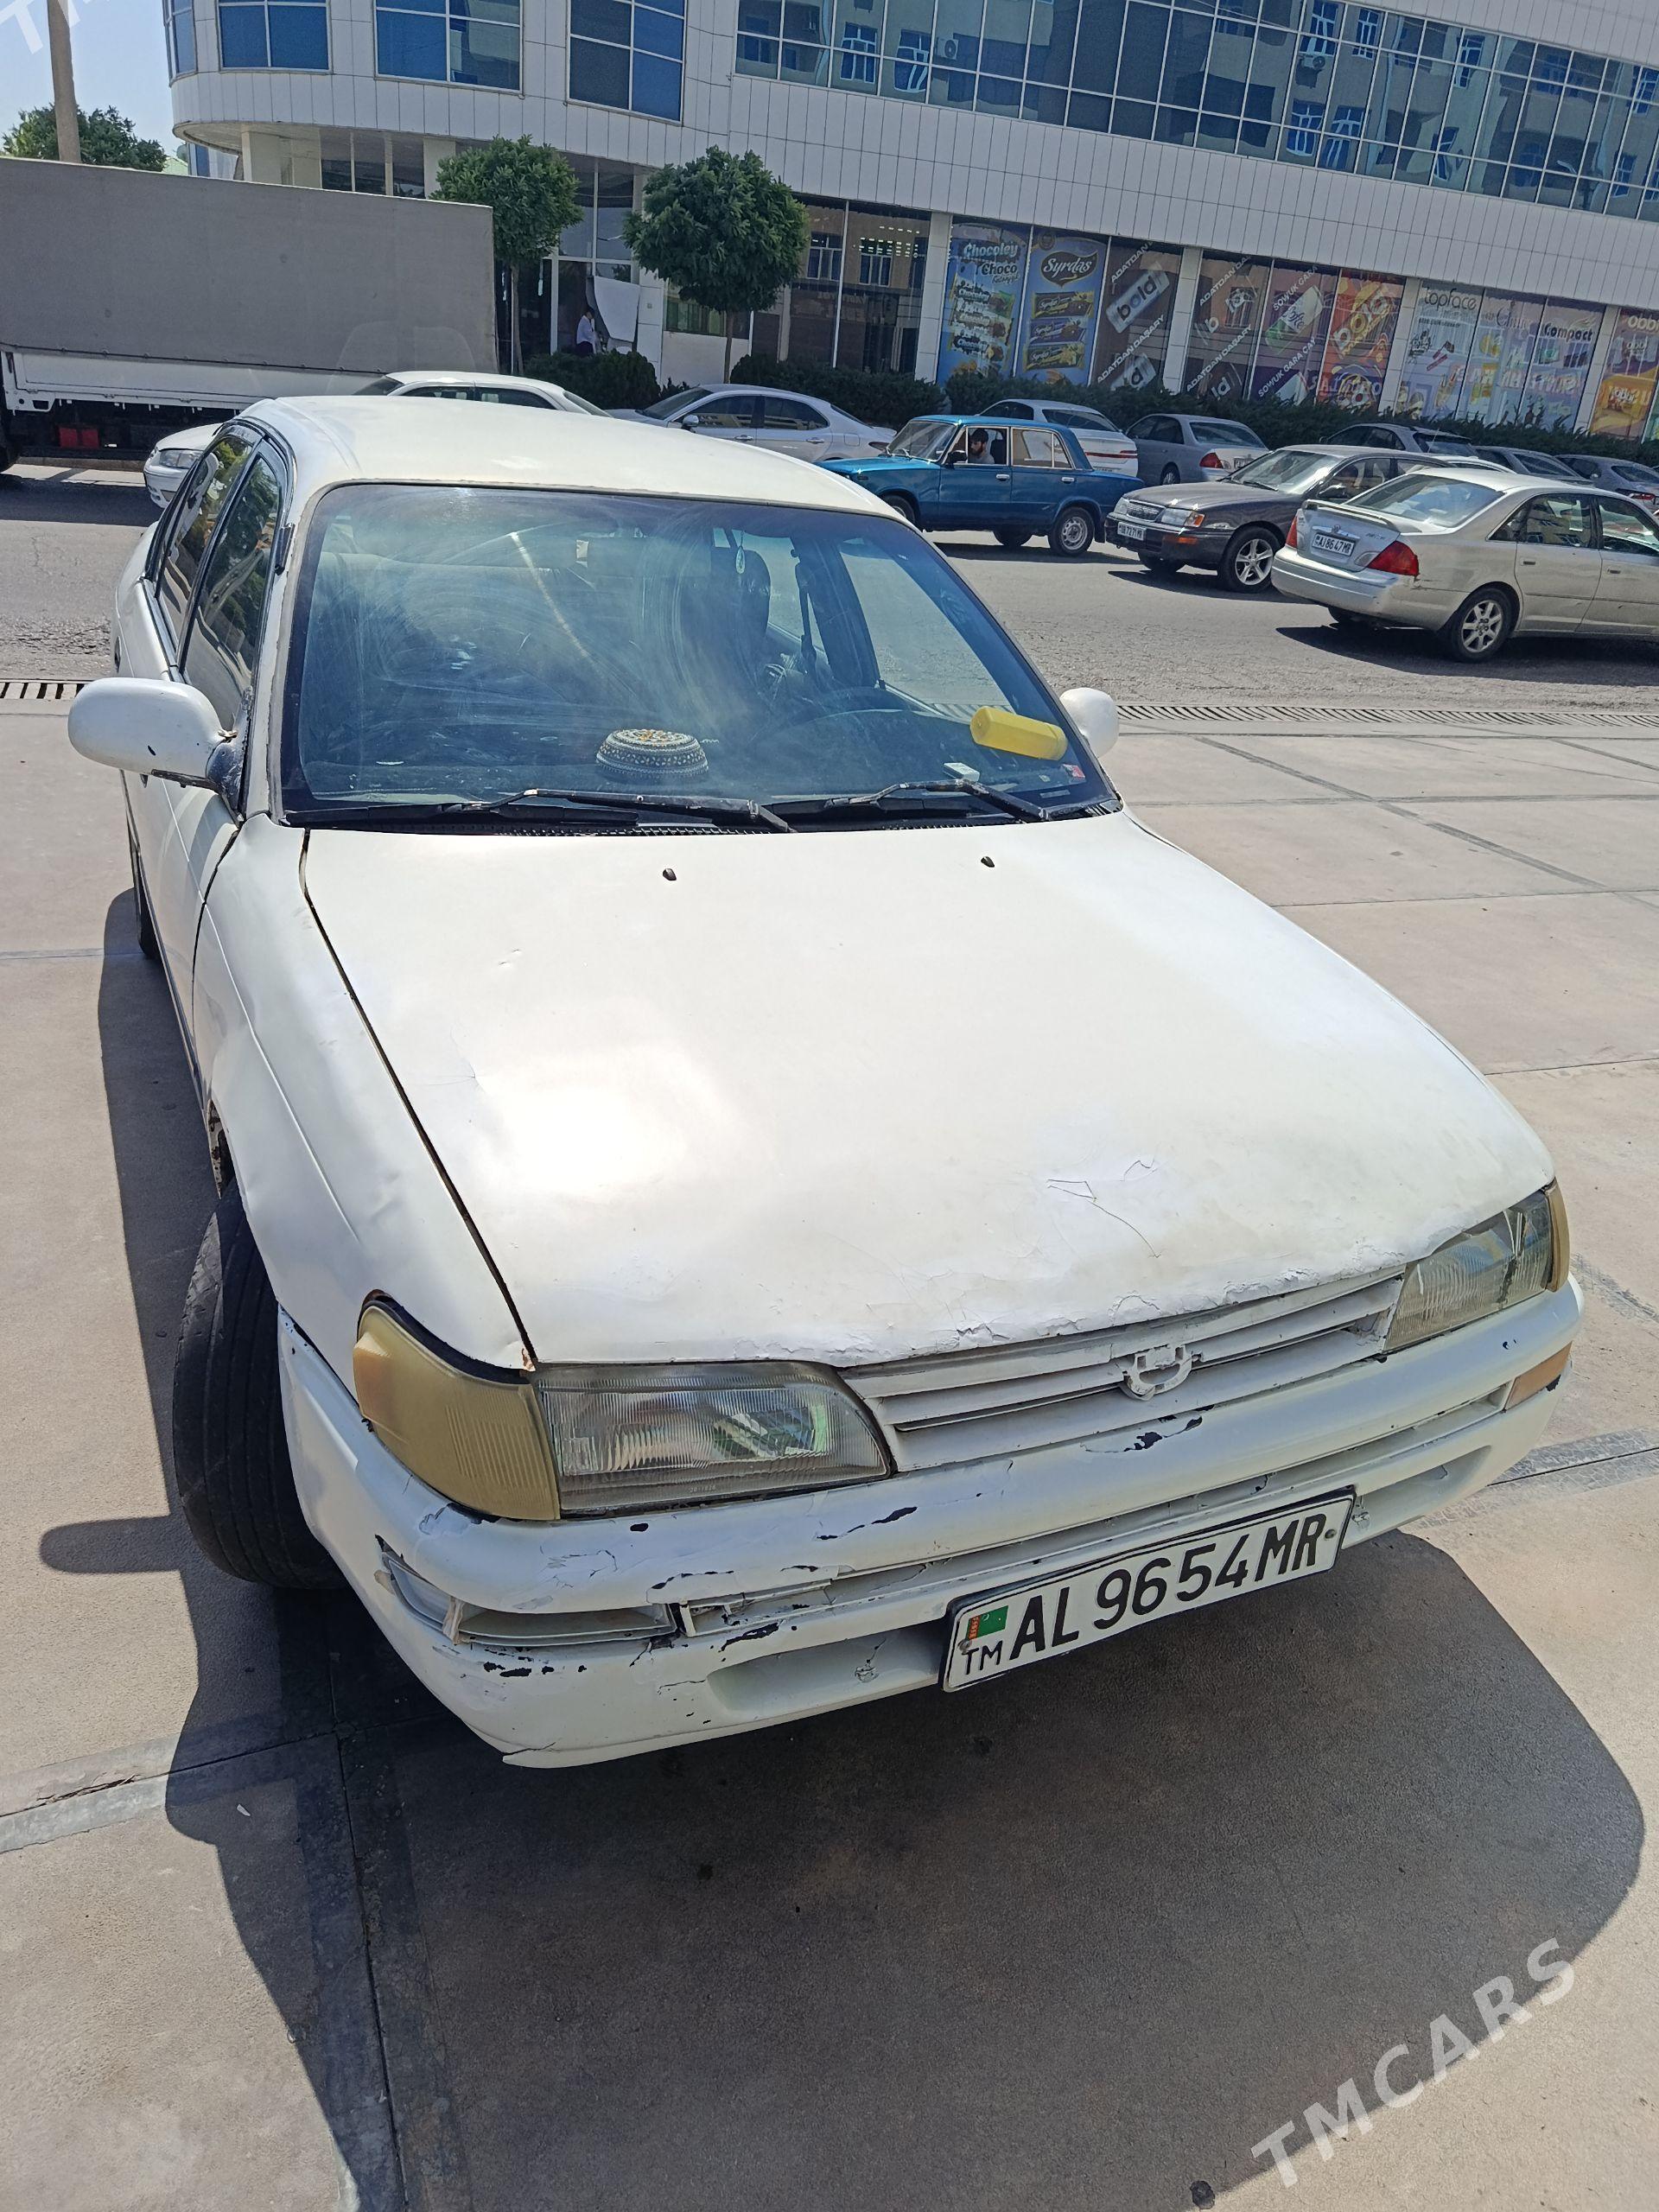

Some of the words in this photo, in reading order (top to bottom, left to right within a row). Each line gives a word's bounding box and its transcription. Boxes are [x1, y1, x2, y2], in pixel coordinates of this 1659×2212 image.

[963, 242, 1019, 257] Chocoley
[1043, 257, 1092, 278] Syrdas
[1111, 243, 1149, 283] ADATDAN
[982, 262, 1018, 276] Choco
[1199, 267, 1236, 307] ADATDAN
[1117, 276, 1158, 321] bold
[1273, 283, 1299, 311] SOWUK
[1425, 287, 1477, 312] topface
[1544, 322, 1593, 343] Compact
[1097, 346, 1134, 384] ADATDAN
[1186, 353, 1223, 391] ADATDAN
[1258, 370, 1285, 397] SOWUK
[1284, 351, 1304, 373] GARA
[963, 1640, 1002, 1676] TM
